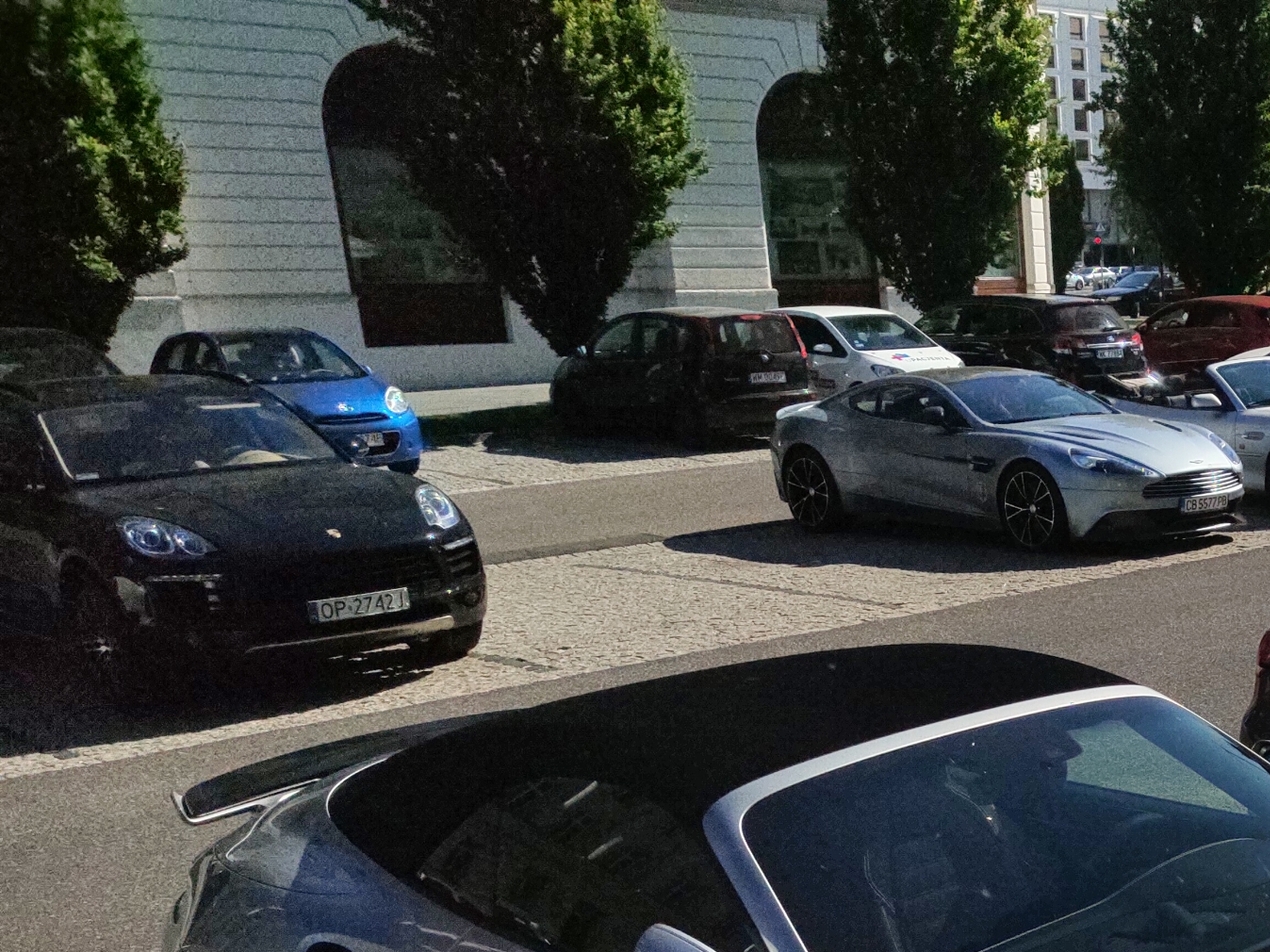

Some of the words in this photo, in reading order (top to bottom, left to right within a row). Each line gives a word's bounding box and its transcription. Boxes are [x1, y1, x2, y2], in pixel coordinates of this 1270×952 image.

[1186, 499, 1197, 511] CB
[321, 600, 347, 619] OP
[353, 591, 404, 615] 2742J
